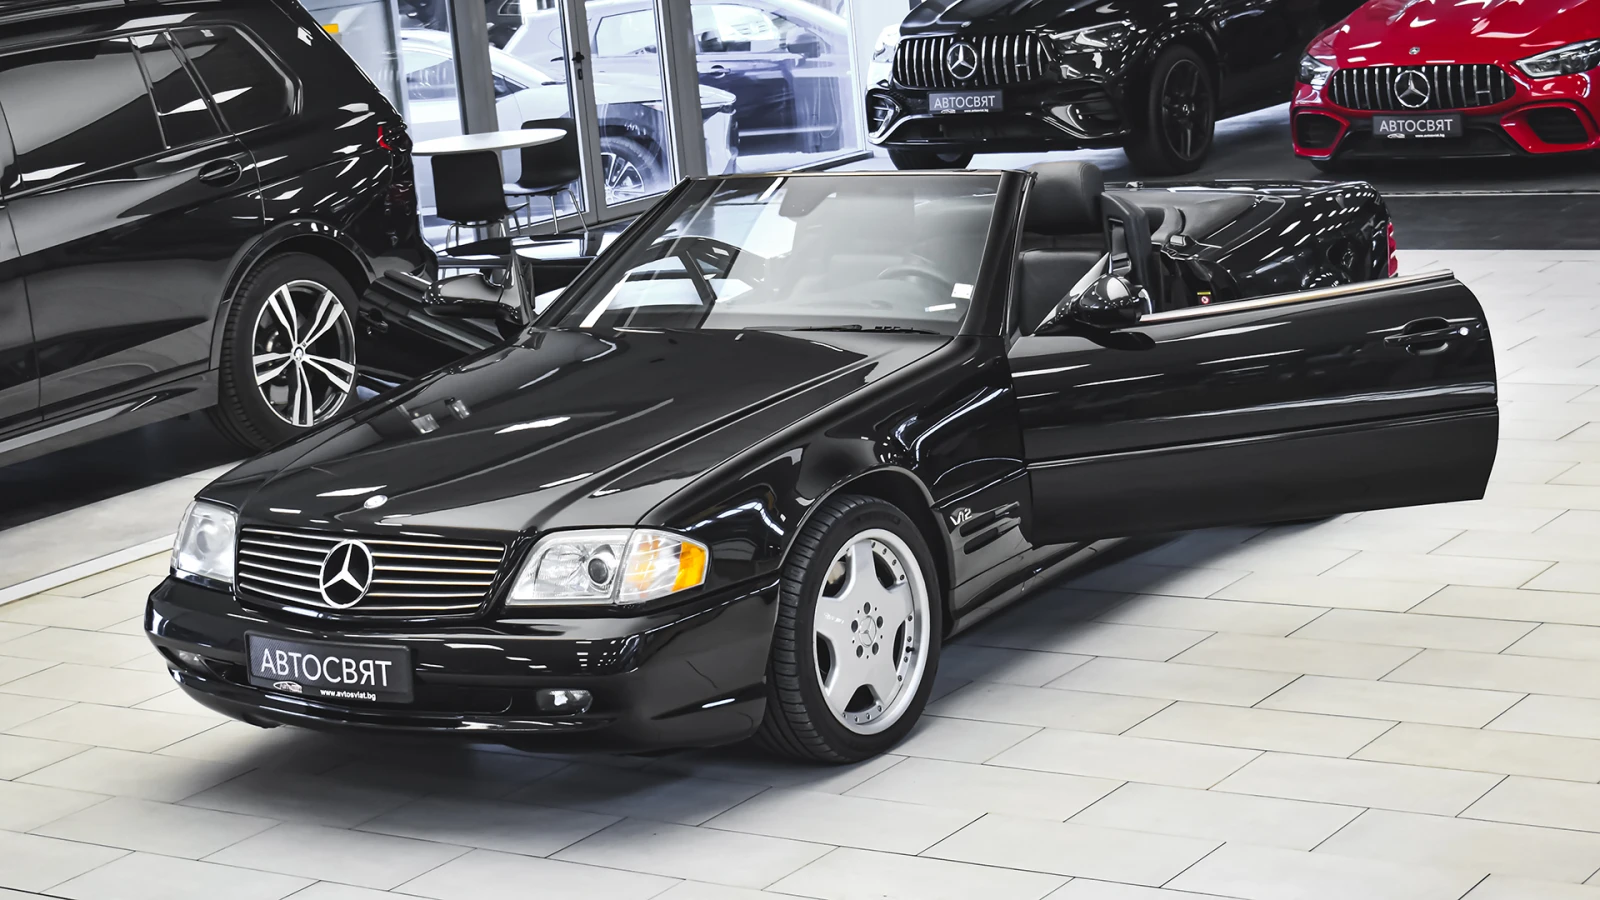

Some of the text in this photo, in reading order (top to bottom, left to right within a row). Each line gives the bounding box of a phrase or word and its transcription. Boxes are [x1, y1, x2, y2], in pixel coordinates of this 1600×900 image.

[934, 95, 996, 109] АВТОСВЯТ
[1379, 119, 1454, 132] АВТОСВЯТ
[949, 507, 973, 526] V12
[260, 648, 392, 687] АВТОСВЯТ
